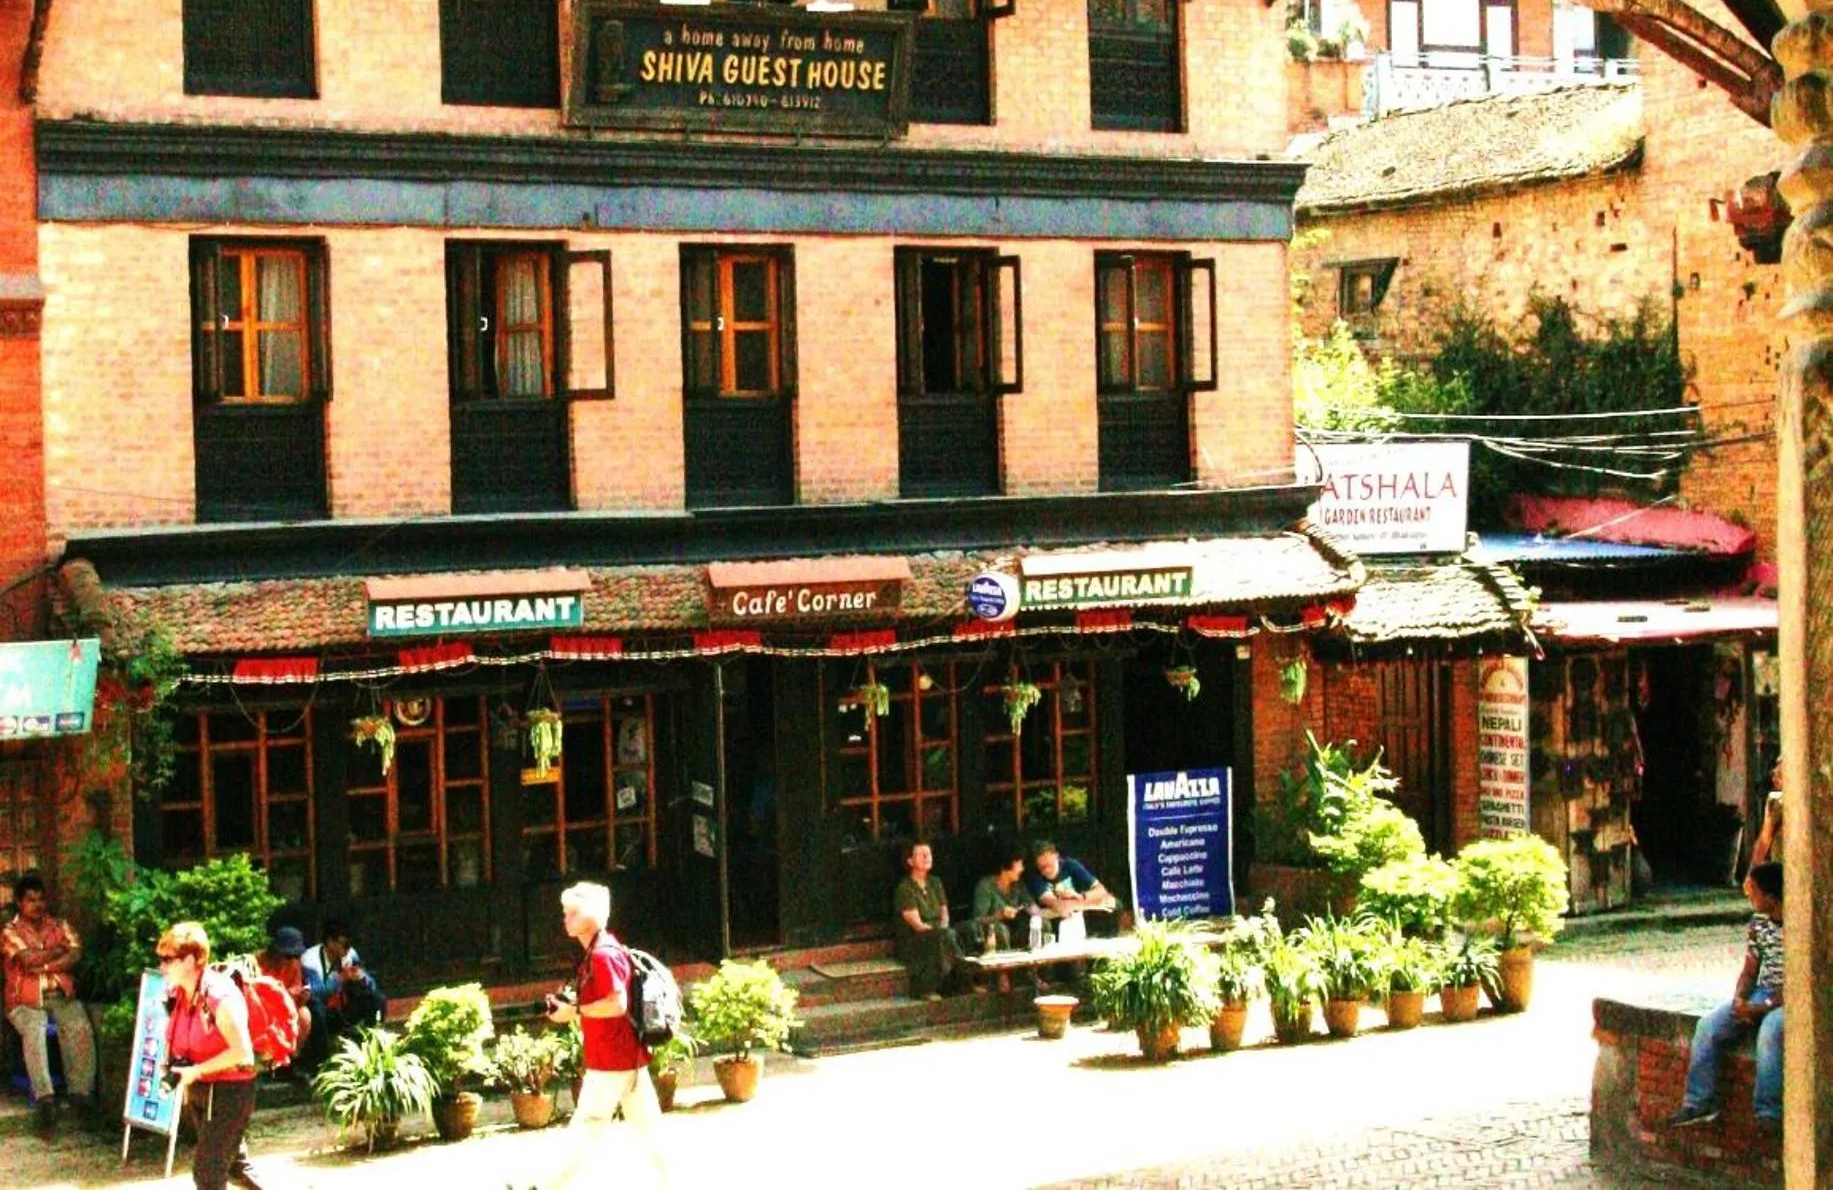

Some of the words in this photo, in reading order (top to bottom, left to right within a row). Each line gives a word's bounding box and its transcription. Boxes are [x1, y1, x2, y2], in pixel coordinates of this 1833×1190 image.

[664, 29, 673, 45] a
[681, 23, 724, 46] home
[731, 33, 770, 52] away
[780, 29, 815, 49] from
[823, 30, 865, 53] home
[640, 50, 714, 83] SHIVA
[723, 54, 803, 88] GUEST
[807, 60, 886, 90] HOUSE
[1315, 471, 1457, 501] ATSHALA
[1369, 506, 1431, 525] RESTAURANT
[797, 588, 877, 613] Corner
[1025, 572, 1188, 602] RESTAURANT
[375, 596, 575, 630] RESTAURANT
[1481, 716, 1522, 731] NEPALI
[1143, 771, 1220, 802] LAVAZZA
[1148, 826, 1178, 838] Double
[1160, 838, 1205, 849] Americano
[1158, 851, 1208, 863] Cappuccino
